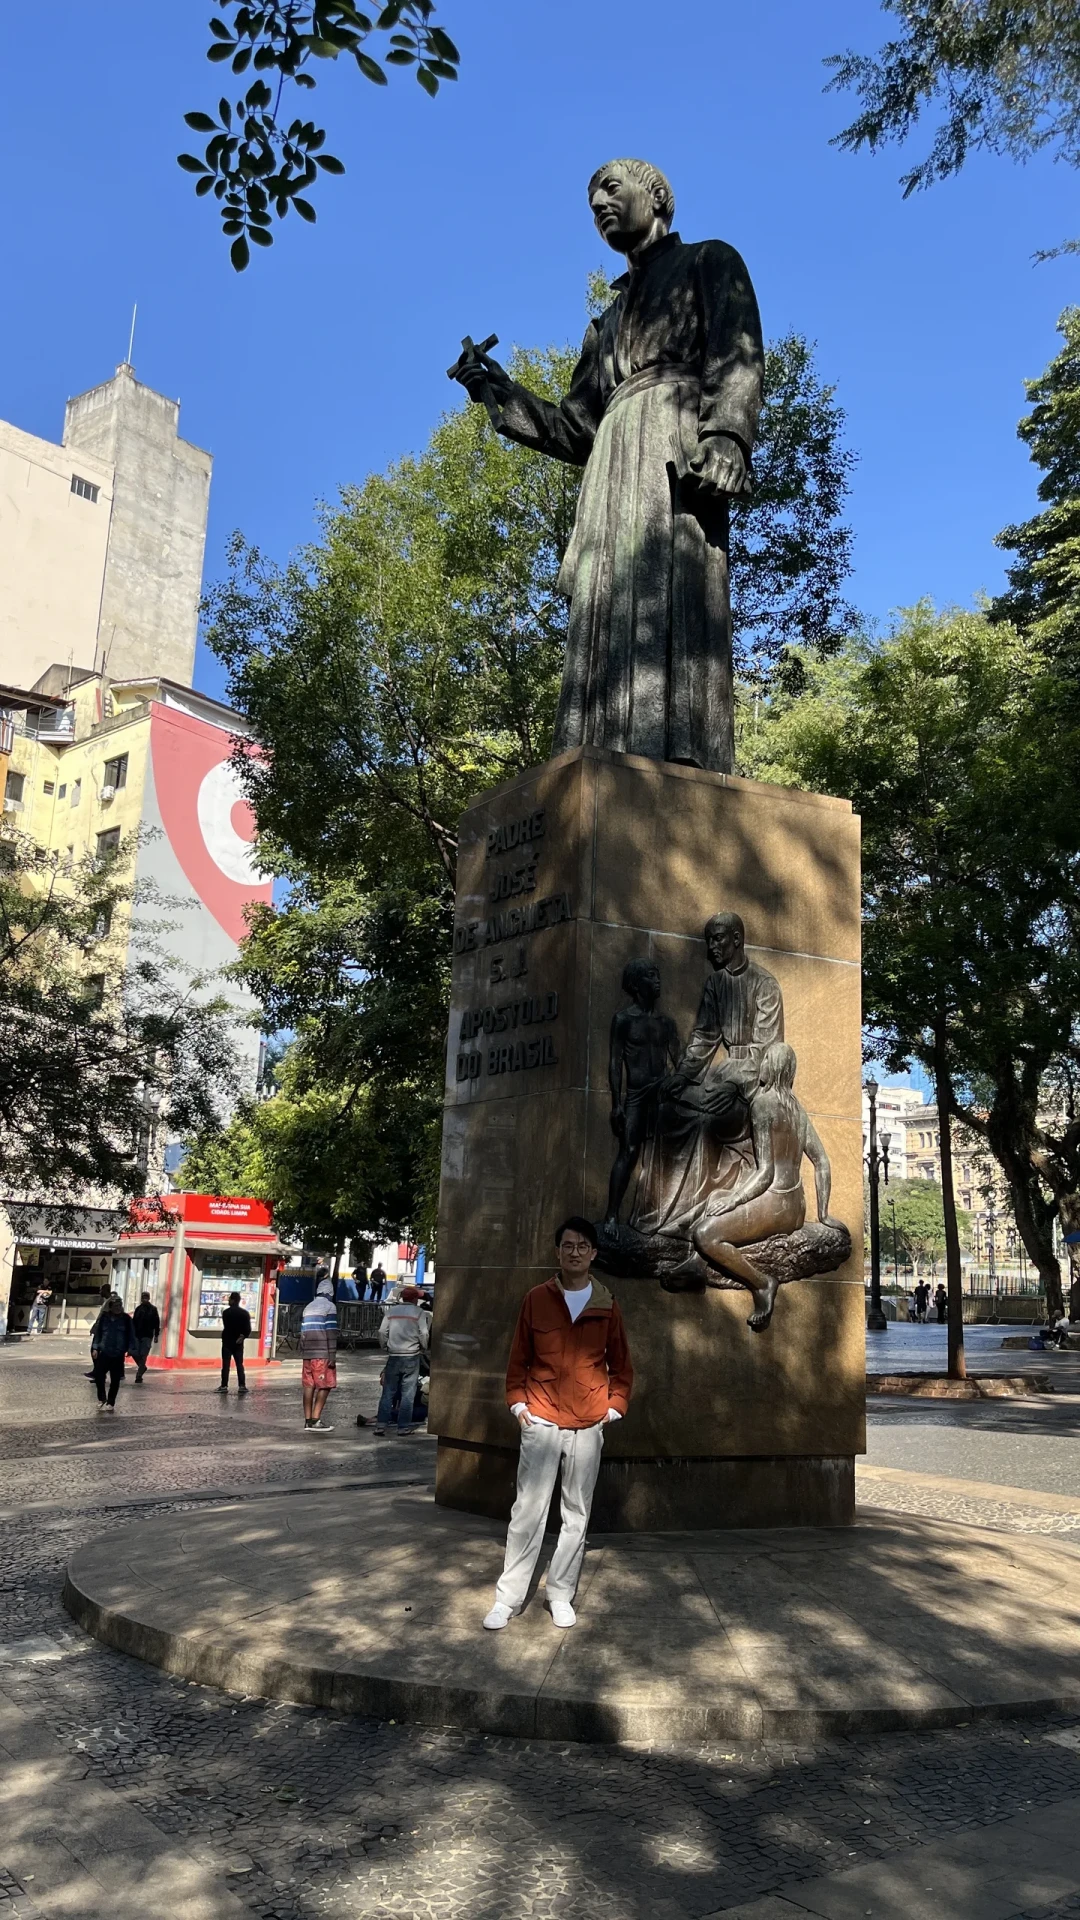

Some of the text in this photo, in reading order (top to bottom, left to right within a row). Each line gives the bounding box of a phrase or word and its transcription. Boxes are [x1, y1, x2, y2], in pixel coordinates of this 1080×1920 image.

[486, 809, 546, 858] PADRE
[489, 853, 540, 903] JOSÉ
[454, 892, 571, 954] DE ANCHIETA
[459, 991, 559, 1041] APOSTOLO
[455, 1035, 559, 1082] DO BRASIL
